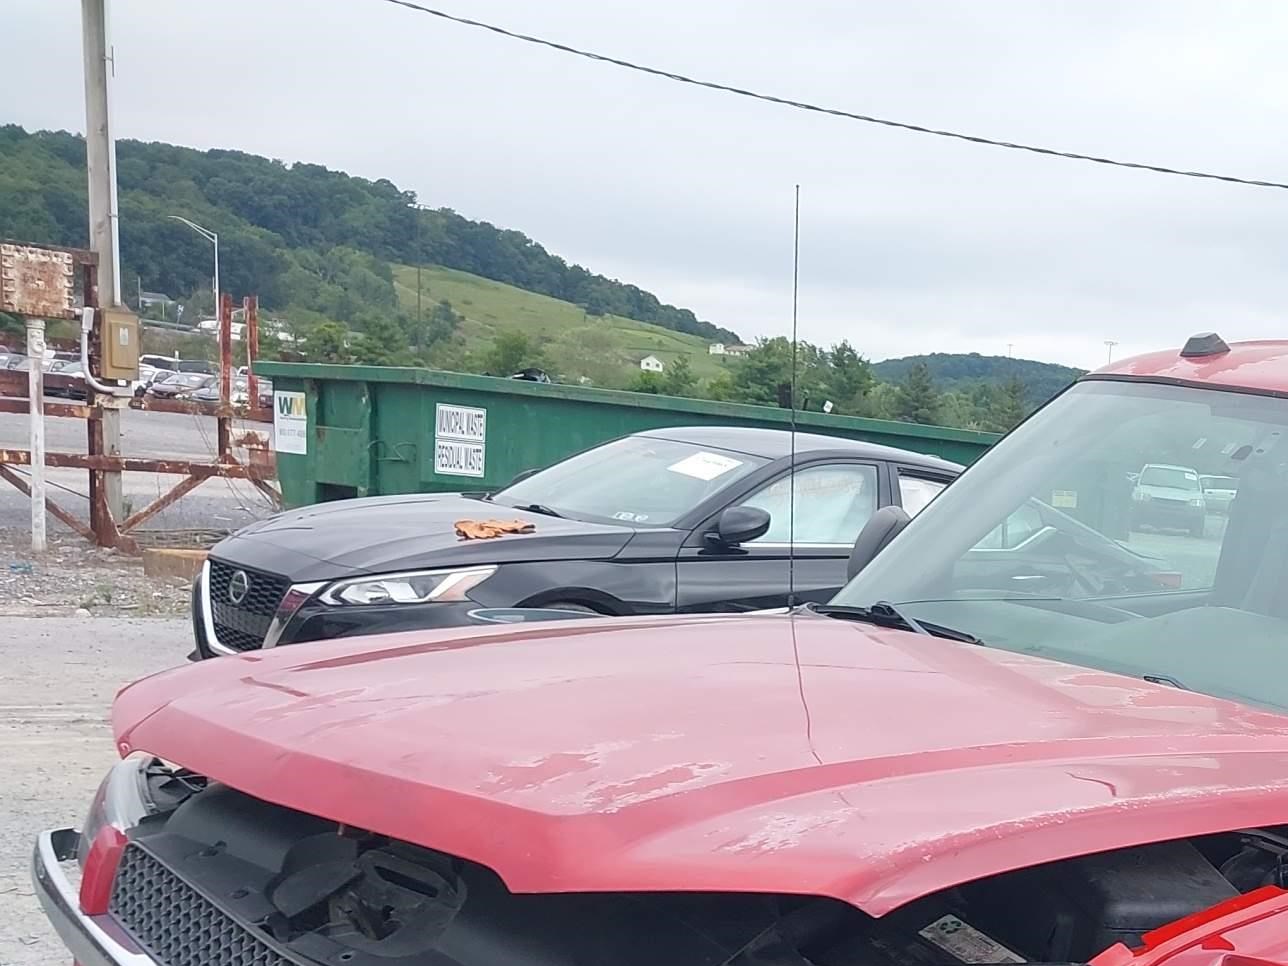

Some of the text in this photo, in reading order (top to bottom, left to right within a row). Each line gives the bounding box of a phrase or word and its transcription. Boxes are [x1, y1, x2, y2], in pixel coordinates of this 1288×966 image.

[279, 396, 306, 416] WM
[466, 412, 484, 437] WASTE
[464, 447, 482, 471] WASTE
